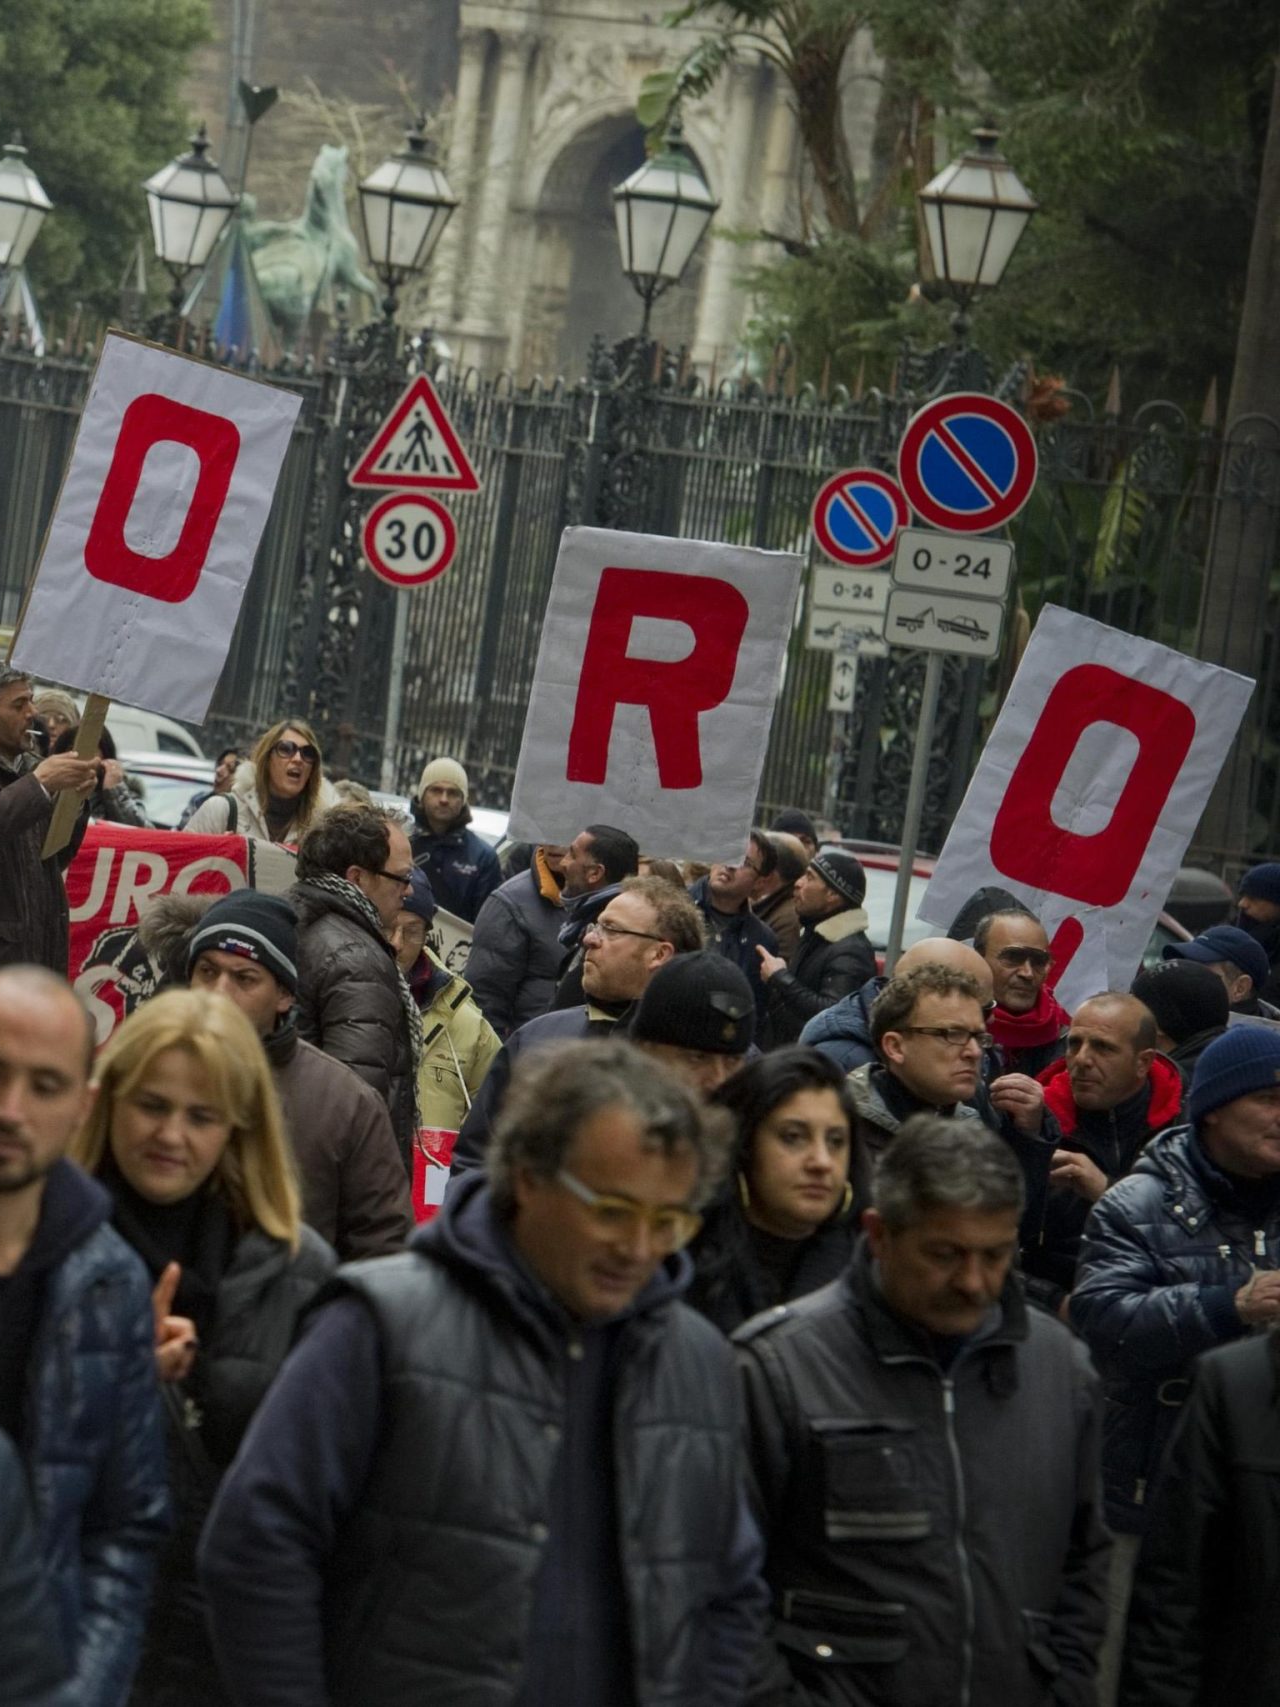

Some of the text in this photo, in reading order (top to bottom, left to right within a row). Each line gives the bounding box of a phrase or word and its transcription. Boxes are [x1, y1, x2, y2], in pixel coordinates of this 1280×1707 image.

[84, 393, 240, 603] O
[385, 519, 436, 561] 30
[566, 567, 750, 789] R
[989, 663, 1197, 907] O
